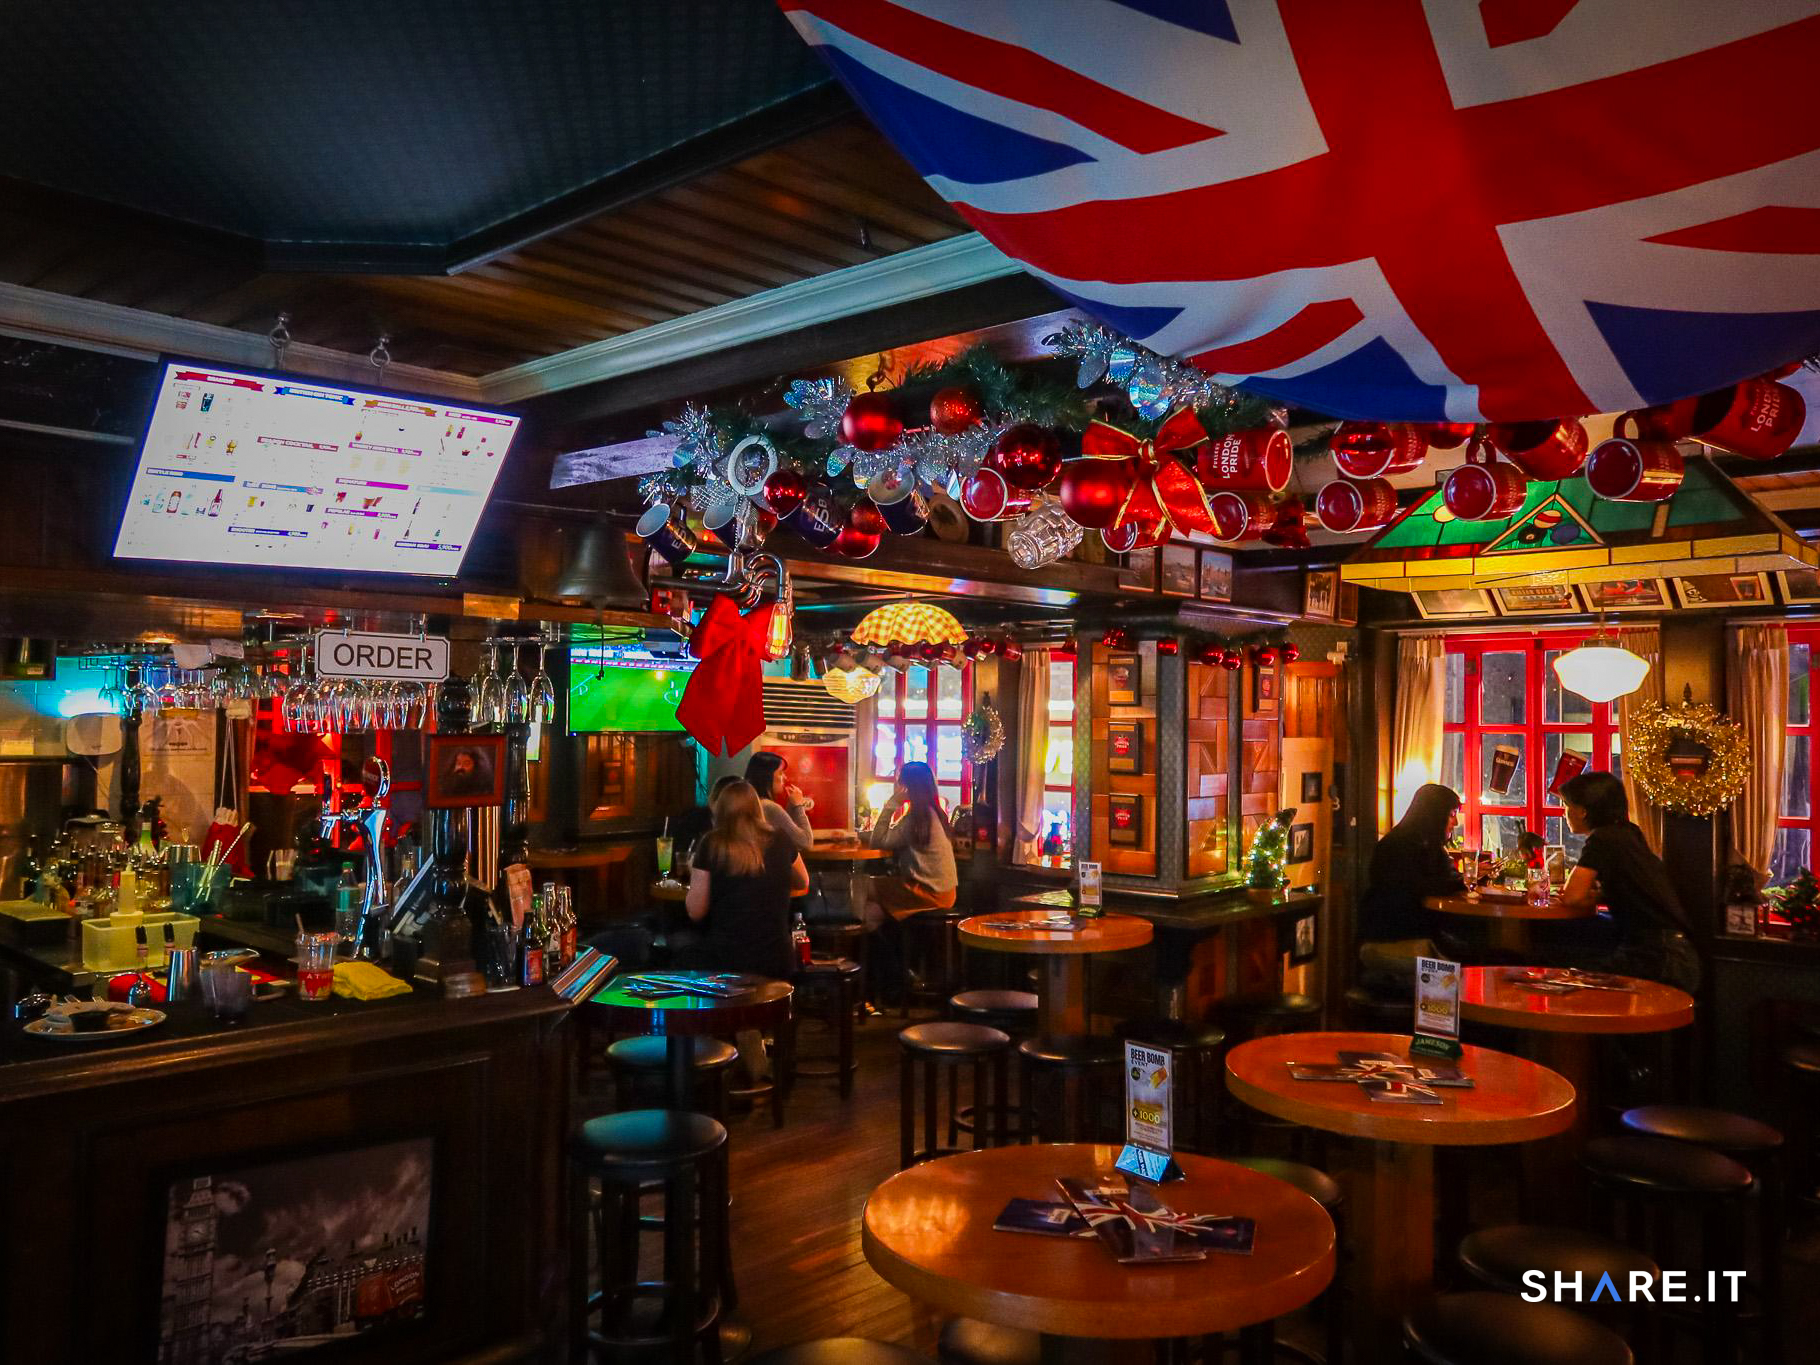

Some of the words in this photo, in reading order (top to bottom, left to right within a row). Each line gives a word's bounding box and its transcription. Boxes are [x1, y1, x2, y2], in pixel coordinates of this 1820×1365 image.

[1221, 434, 1235, 479] LONDON
[1229, 439, 1242, 473] PRIDE
[813, 498, 830, 533] ESB
[333, 643, 433, 670] ORDER
[1130, 1048, 1146, 1061] BEER
[1147, 1052, 1166, 1066] BOMB
